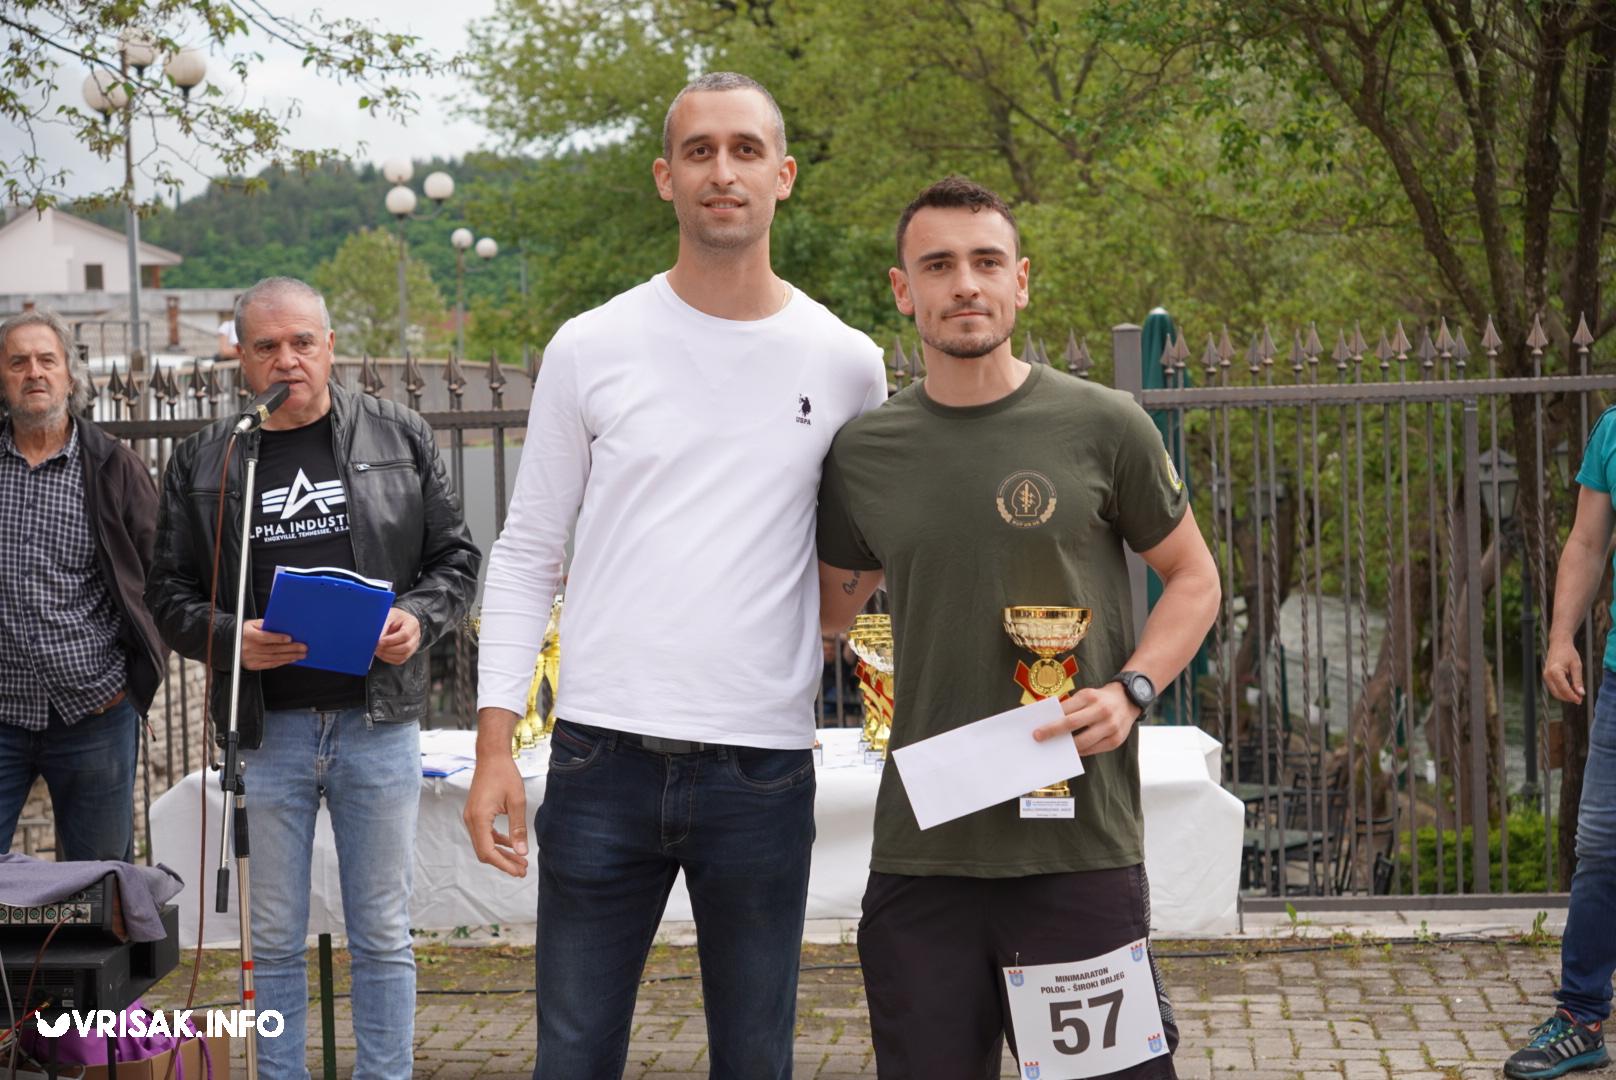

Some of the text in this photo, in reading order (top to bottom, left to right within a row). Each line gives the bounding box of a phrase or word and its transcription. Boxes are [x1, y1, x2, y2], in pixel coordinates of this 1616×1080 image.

[249, 513, 350, 540] PHA INDUST
[1040, 986, 1066, 994] POLOG
[1073, 980, 1099, 992] ŠIROKI
[1100, 971, 1125, 986] BRIJEG
[1055, 966, 1109, 983] MINIMARATON
[1049, 988, 1124, 1055] 57
